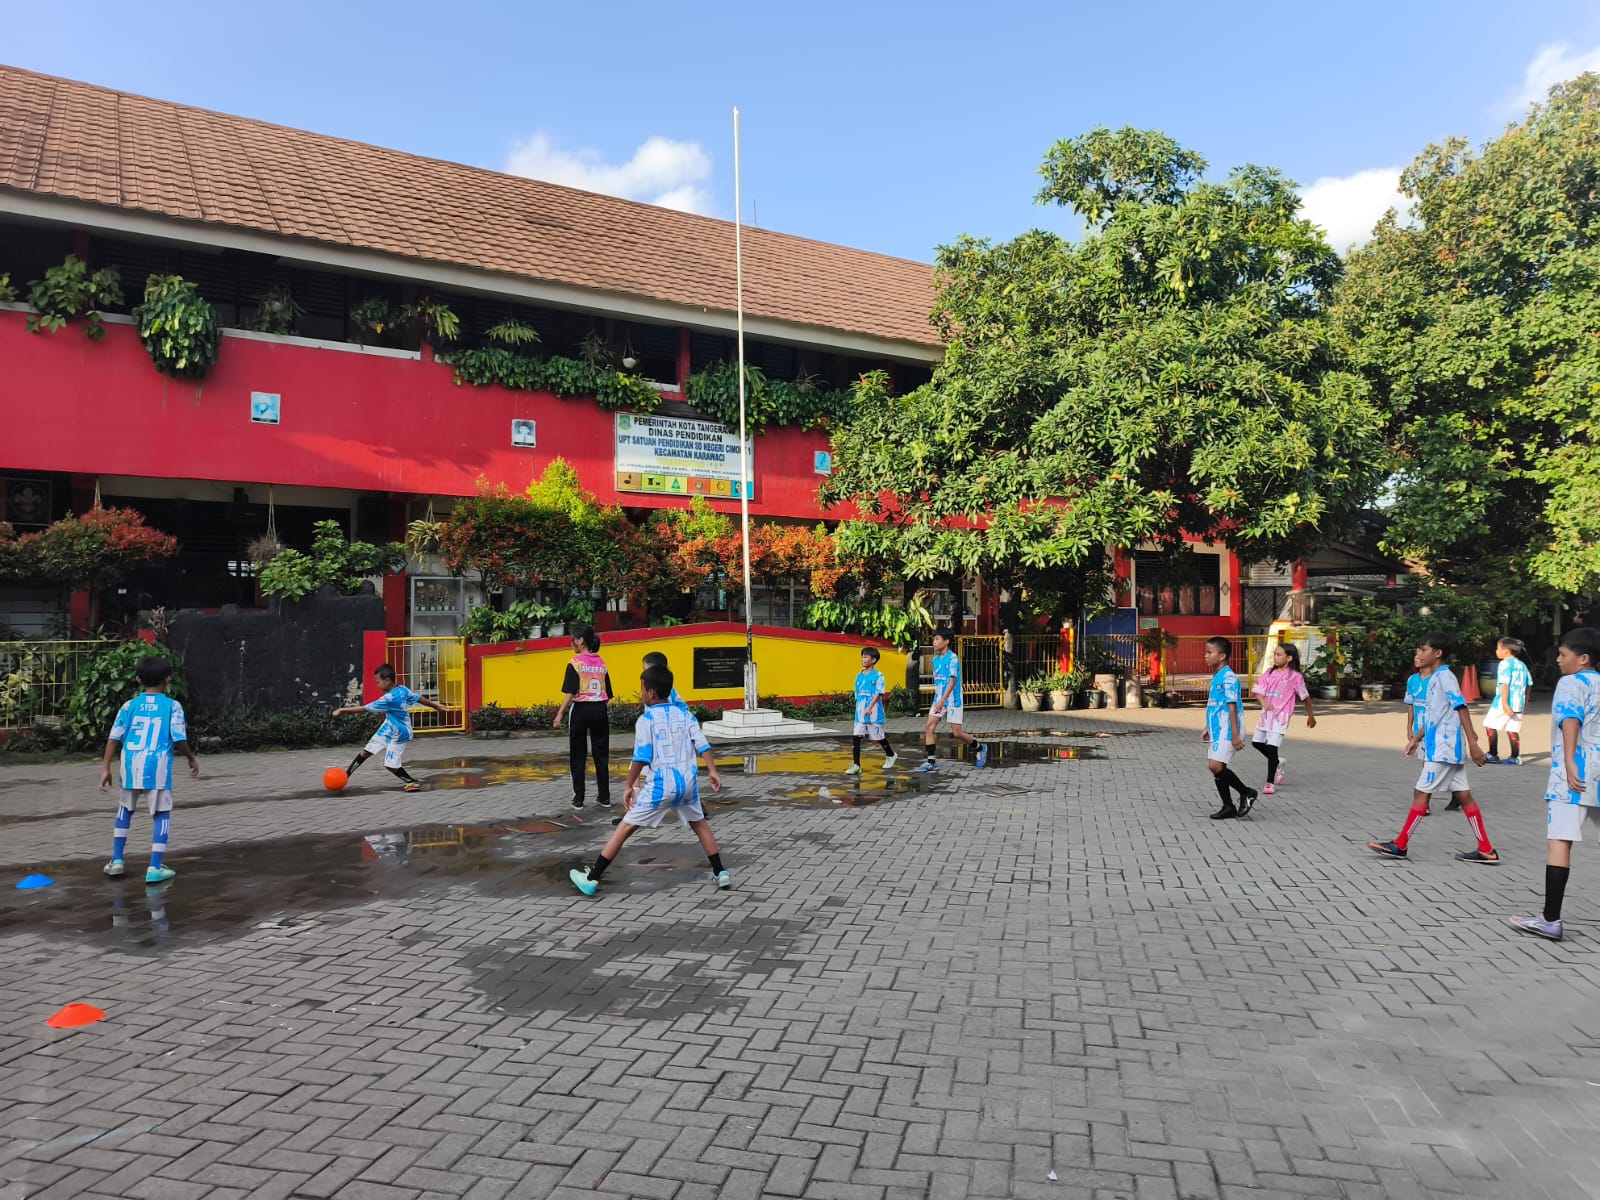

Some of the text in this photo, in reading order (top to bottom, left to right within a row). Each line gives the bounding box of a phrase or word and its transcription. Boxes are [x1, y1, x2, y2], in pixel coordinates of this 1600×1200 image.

[634, 416, 736, 435] PEMERINTAH KOTA TANGERA
[618, 434, 631, 444] UPT
[632, 436, 657, 446] SATUAN
[658, 438, 694, 450] PENDIDIKAN
[695, 442, 702, 450] SD
[703, 442, 725, 452] NEGERI
[726, 444, 747, 455] CIMO
[649, 428, 722, 443] DINAS PENDIDIKAN
[655, 447, 725, 462] KECAMATAN KARAWACI
[127, 716, 162, 751] 31
